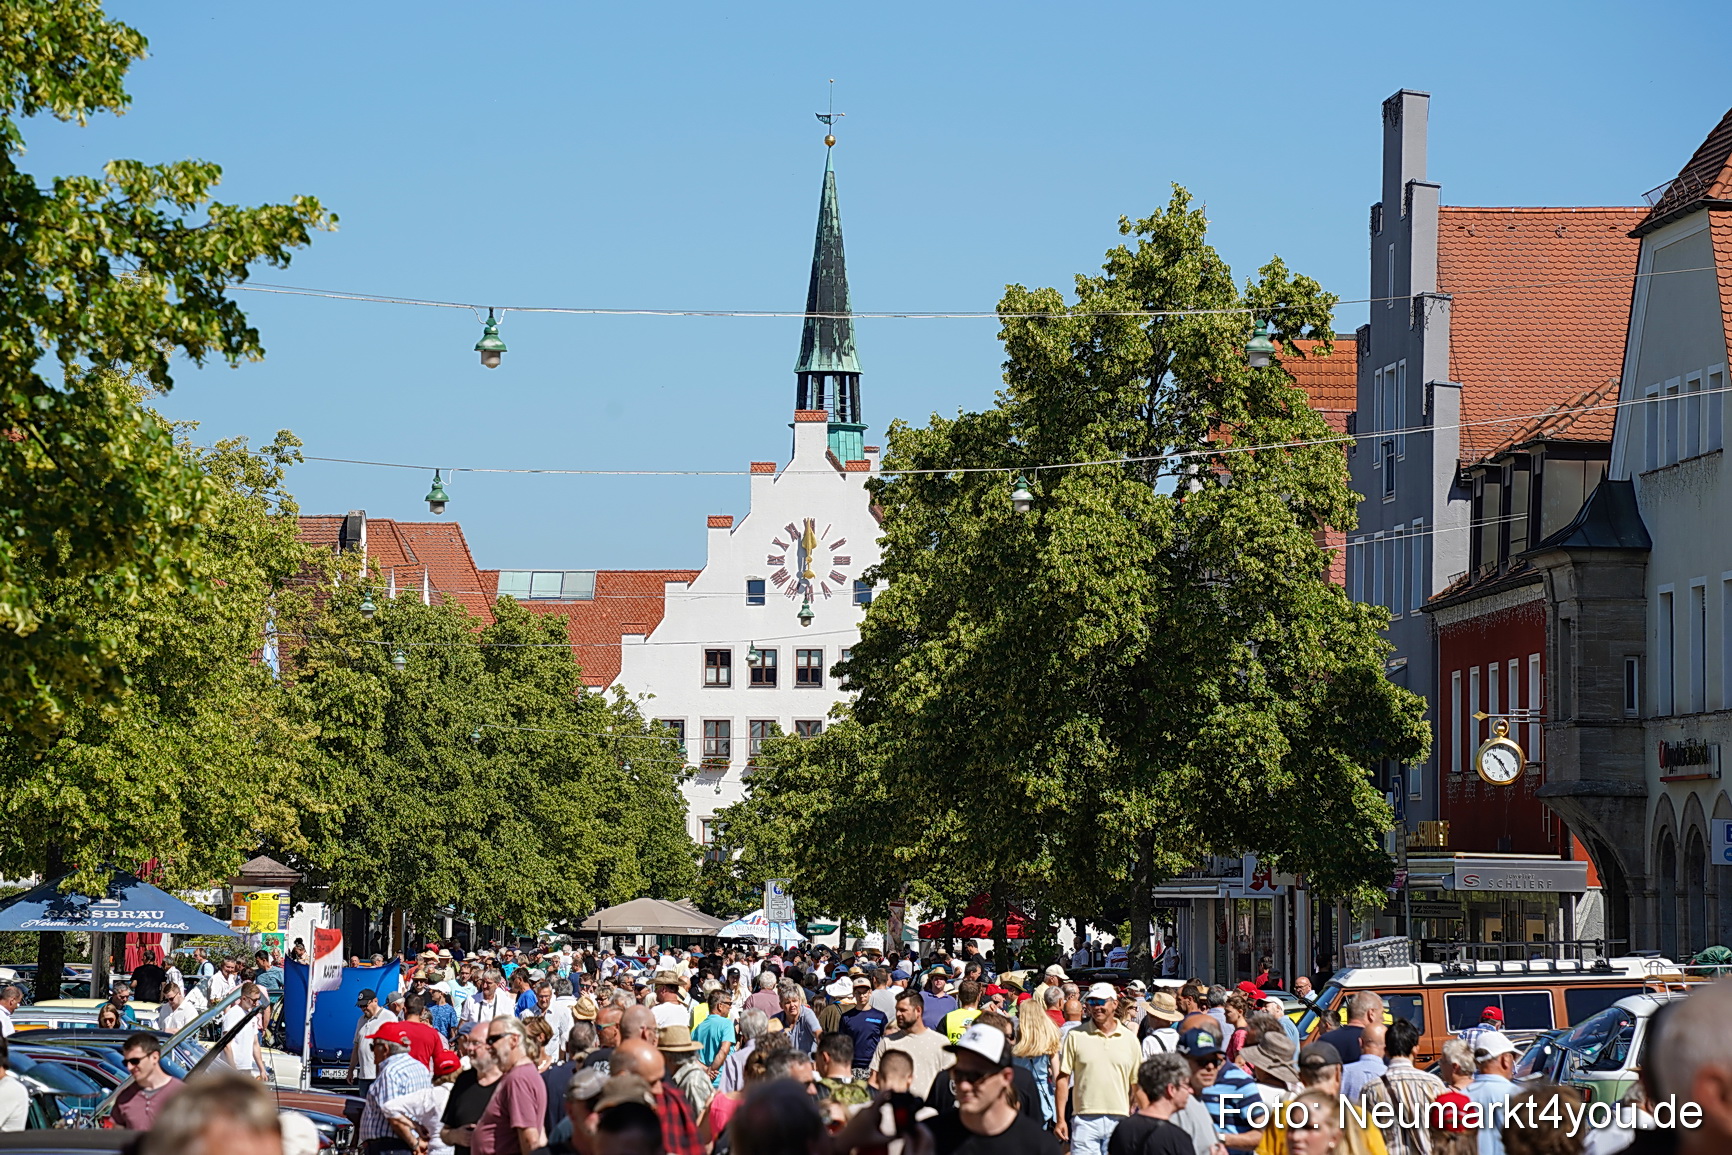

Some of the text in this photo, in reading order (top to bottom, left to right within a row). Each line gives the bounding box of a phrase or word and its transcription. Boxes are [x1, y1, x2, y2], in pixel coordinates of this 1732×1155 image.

[1488, 879, 1553, 890] SCHLIERF
[101, 921, 136, 929] guter
[135, 920, 190, 931] Schluck
